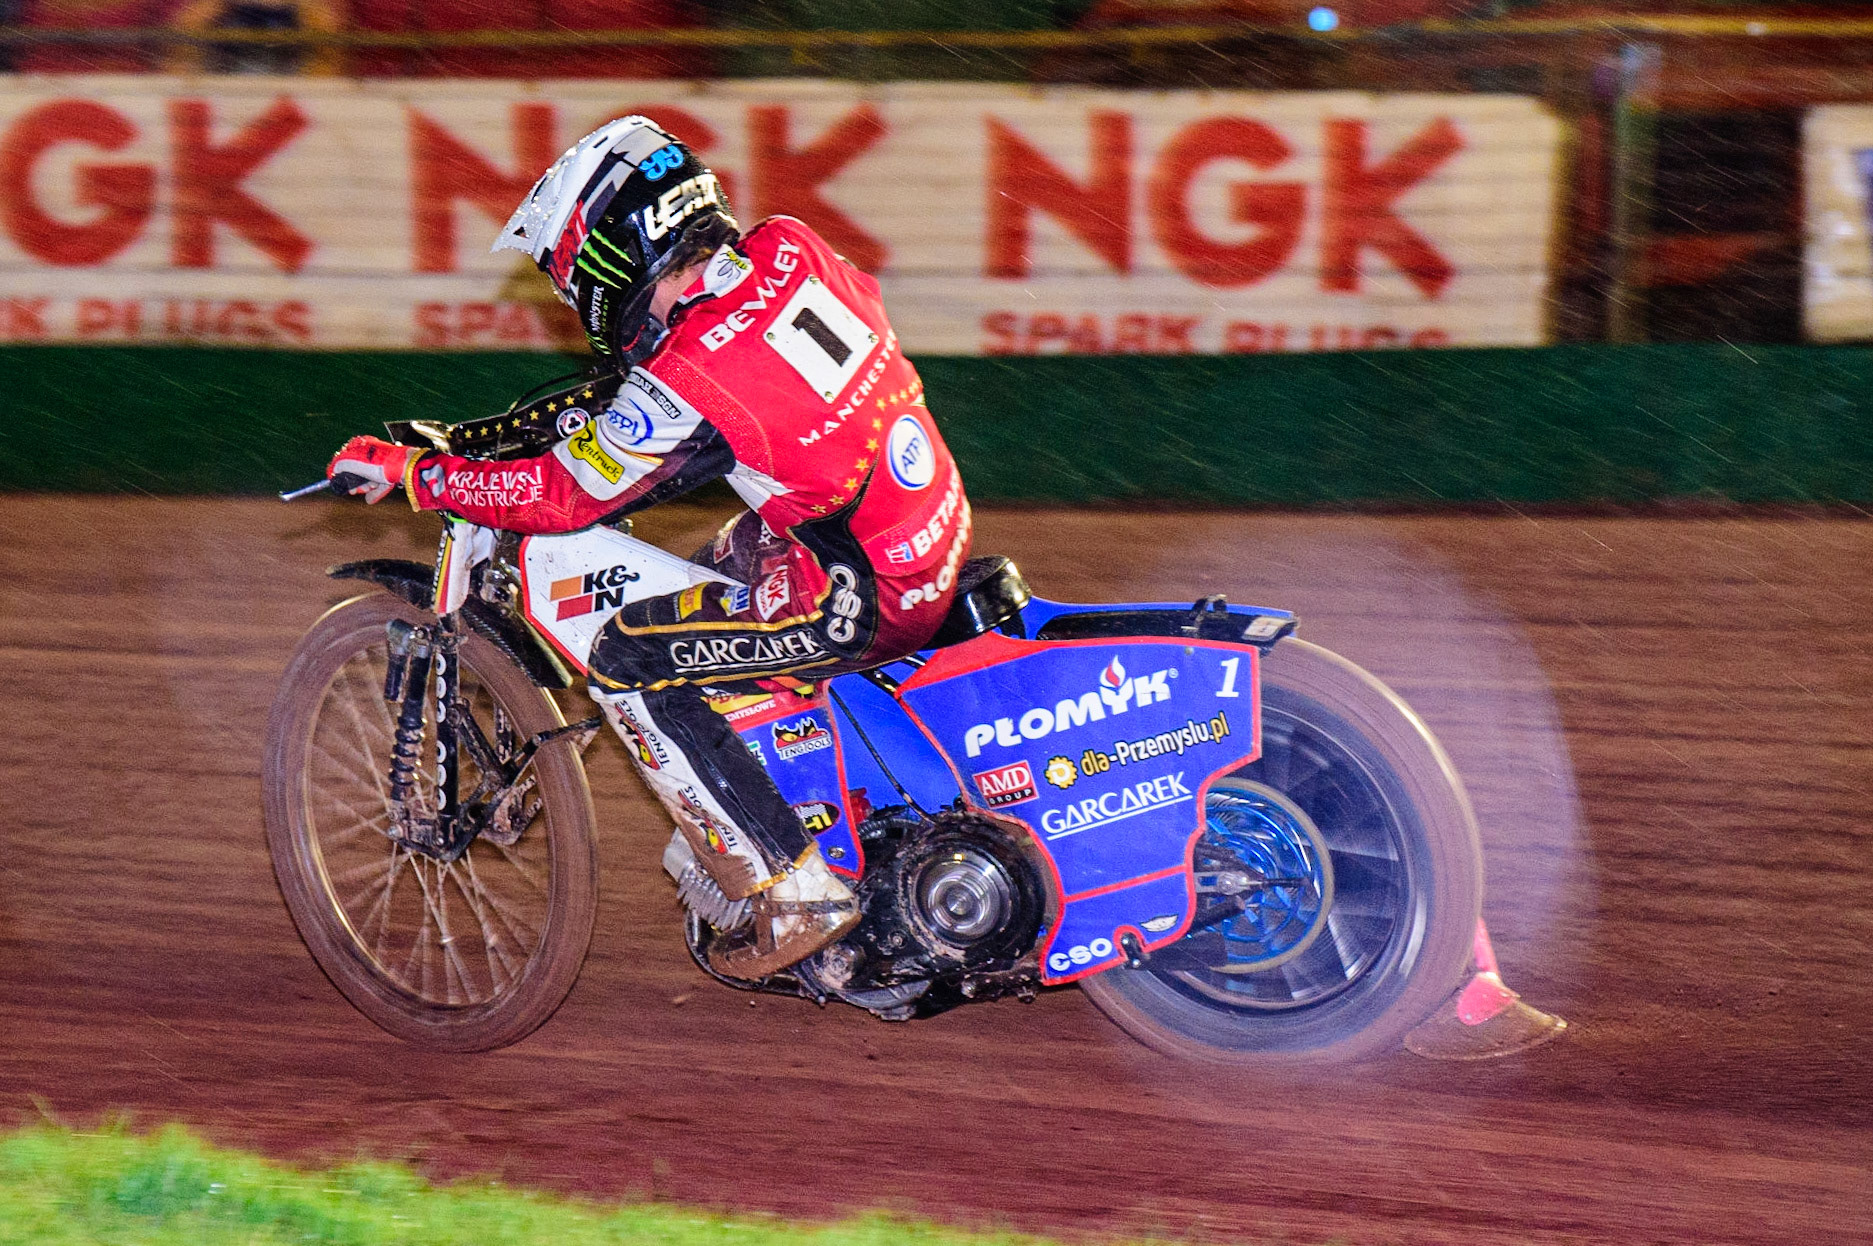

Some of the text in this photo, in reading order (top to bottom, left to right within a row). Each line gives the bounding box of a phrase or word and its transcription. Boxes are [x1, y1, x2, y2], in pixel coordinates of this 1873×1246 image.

[638, 144, 684, 181] 99
[982, 107, 1467, 298] NGK
[588, 285, 605, 333] MONSTER
[699, 237, 800, 353] BEWLEY
[792, 307, 853, 367] 1
[574, 426, 621, 479] Rentruck
[767, 568, 788, 608] NGK
[670, 631, 820, 668] GARCAREK
[1216, 656, 1239, 698] 1
[982, 765, 1030, 796] AMD
[989, 788, 1032, 805] GROUP
[1041, 772, 1191, 834] GARCAREK
[1049, 937, 1113, 972] CSO
